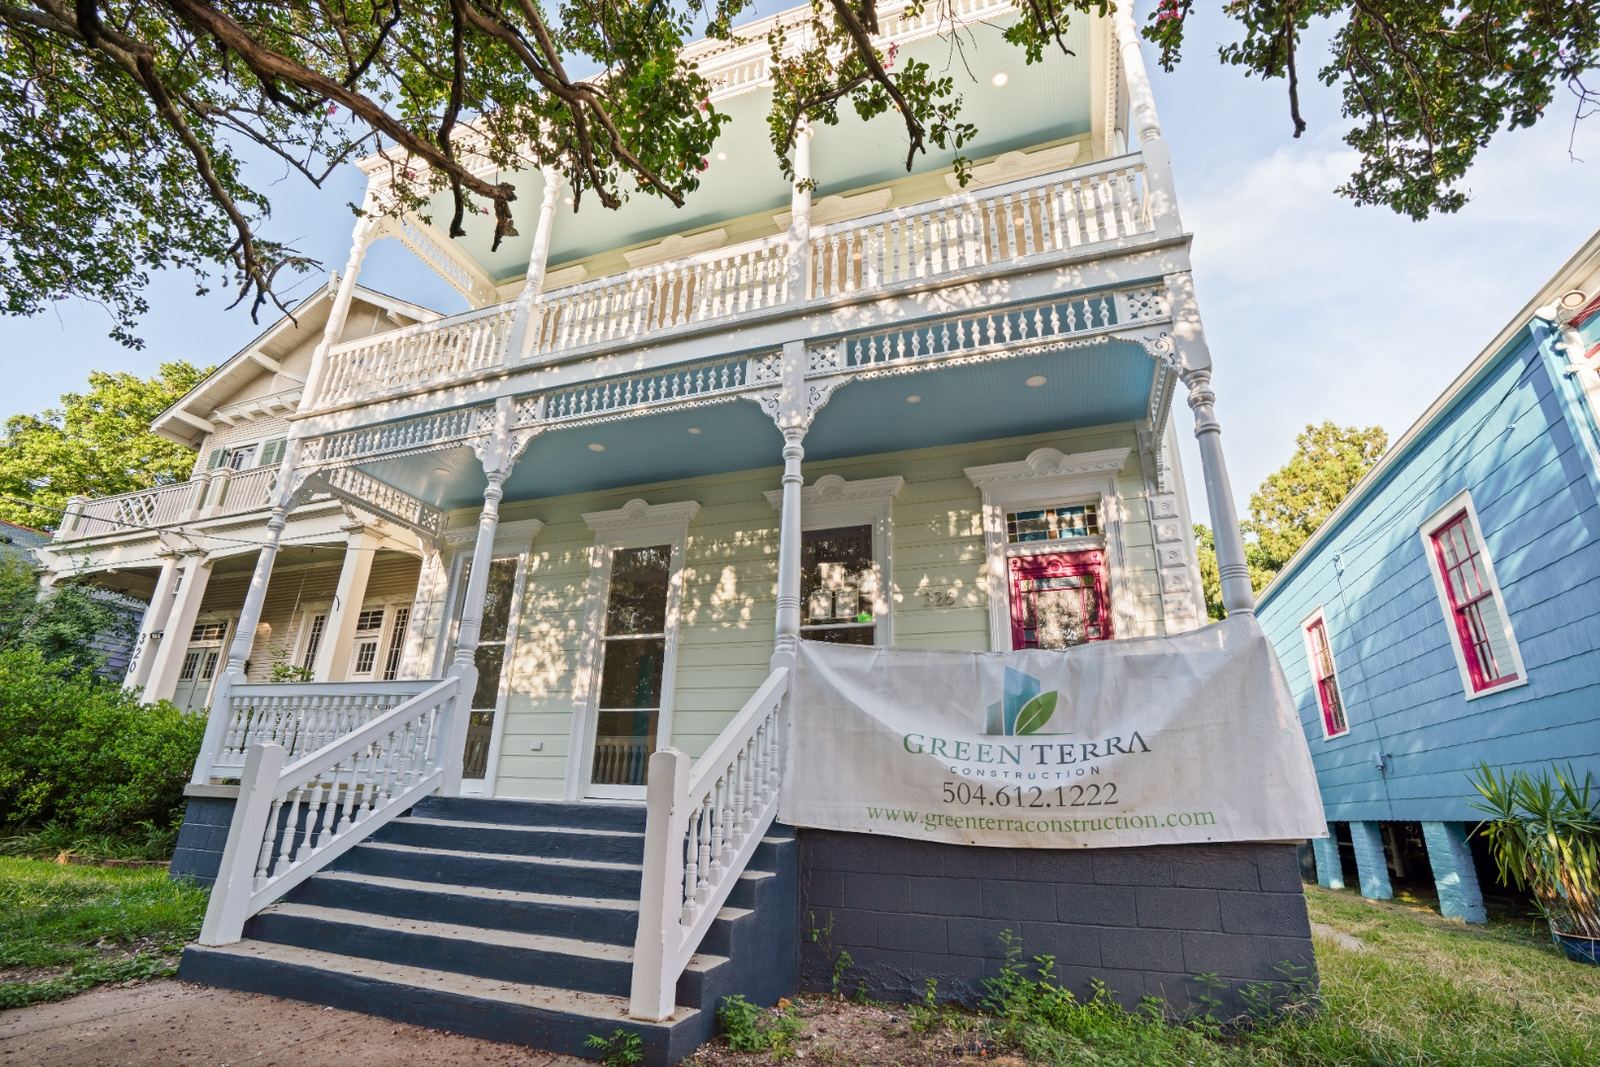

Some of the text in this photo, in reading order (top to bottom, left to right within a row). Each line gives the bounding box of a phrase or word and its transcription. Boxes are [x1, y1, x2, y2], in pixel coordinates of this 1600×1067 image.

[129, 632, 147, 674] 320
[903, 730, 1152, 765] GREEN TERRA
[950, 765, 1100, 780] CONSTRUCTION
[943, 781, 1118, 808] 504.612.1222
[867, 806, 1217, 833] www.greenterraconstruction.com
